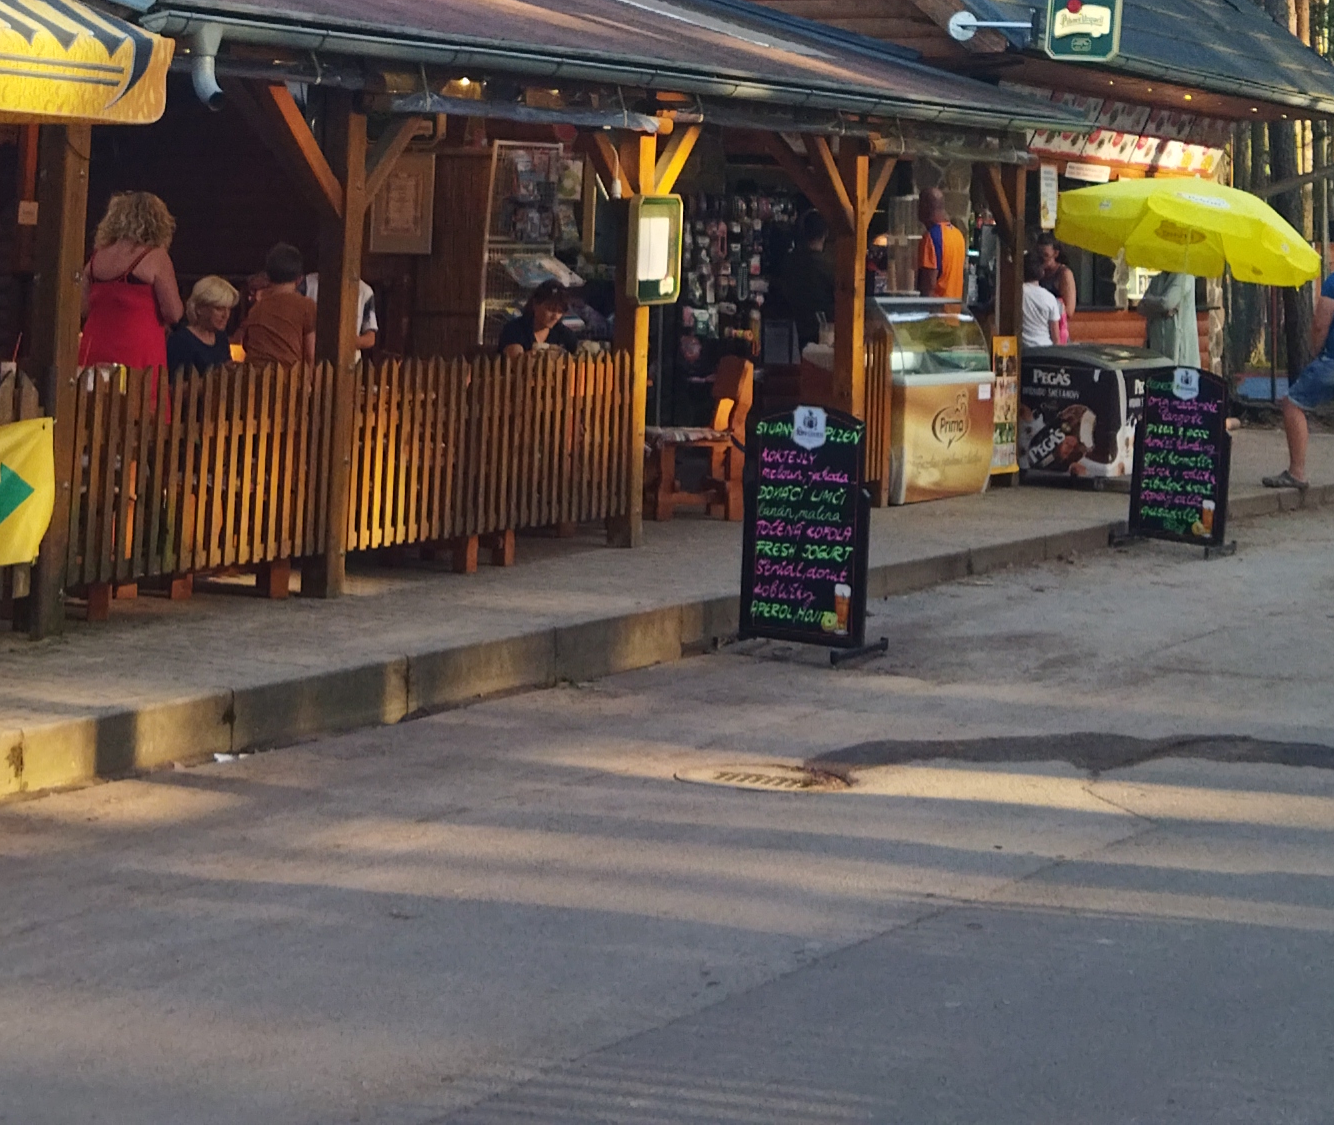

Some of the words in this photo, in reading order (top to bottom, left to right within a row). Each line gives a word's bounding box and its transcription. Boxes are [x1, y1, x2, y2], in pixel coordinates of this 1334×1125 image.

[940, 417, 964, 433] Prima
[757, 485, 808, 501] DOMÁCÍ
[756, 540, 797, 557] FRESH
[802, 544, 854, 562] JOGURT
